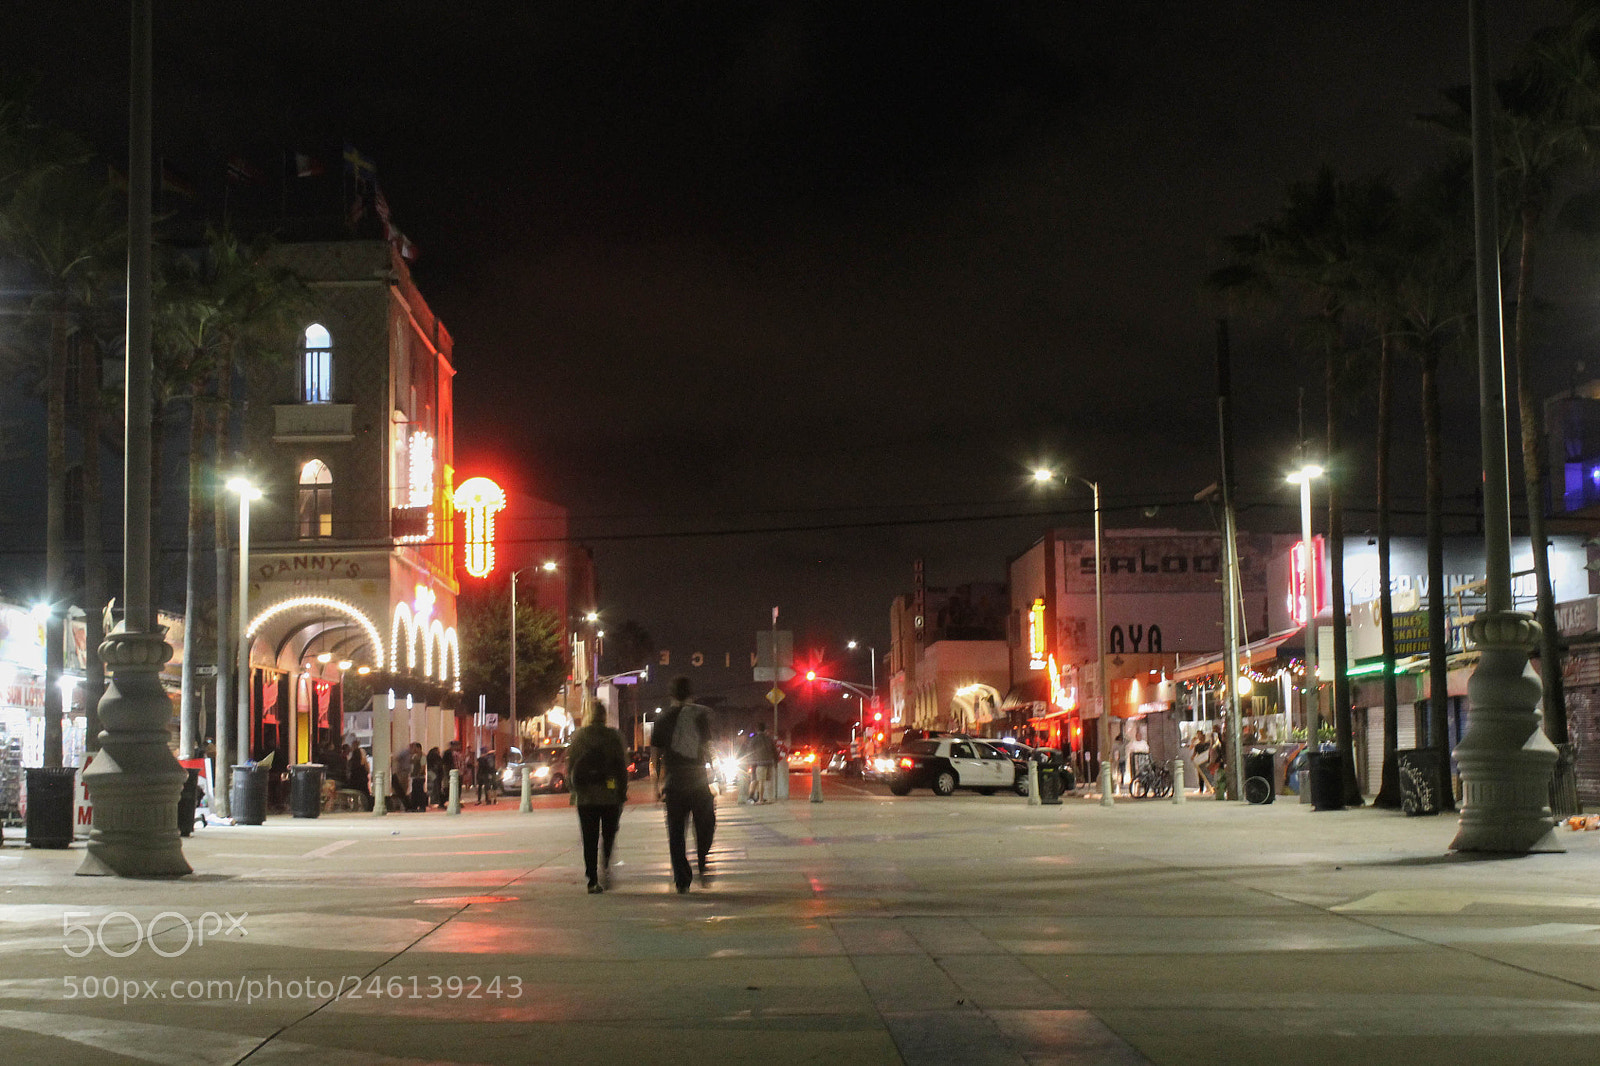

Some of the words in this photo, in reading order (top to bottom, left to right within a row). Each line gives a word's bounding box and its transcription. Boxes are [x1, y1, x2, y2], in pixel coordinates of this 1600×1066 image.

[259, 555, 360, 579] DANNY'S
[1555, 603, 1586, 632] NTAGE
[1110, 624, 1162, 653] AYA
[1395, 640, 1431, 654] SURFIN
